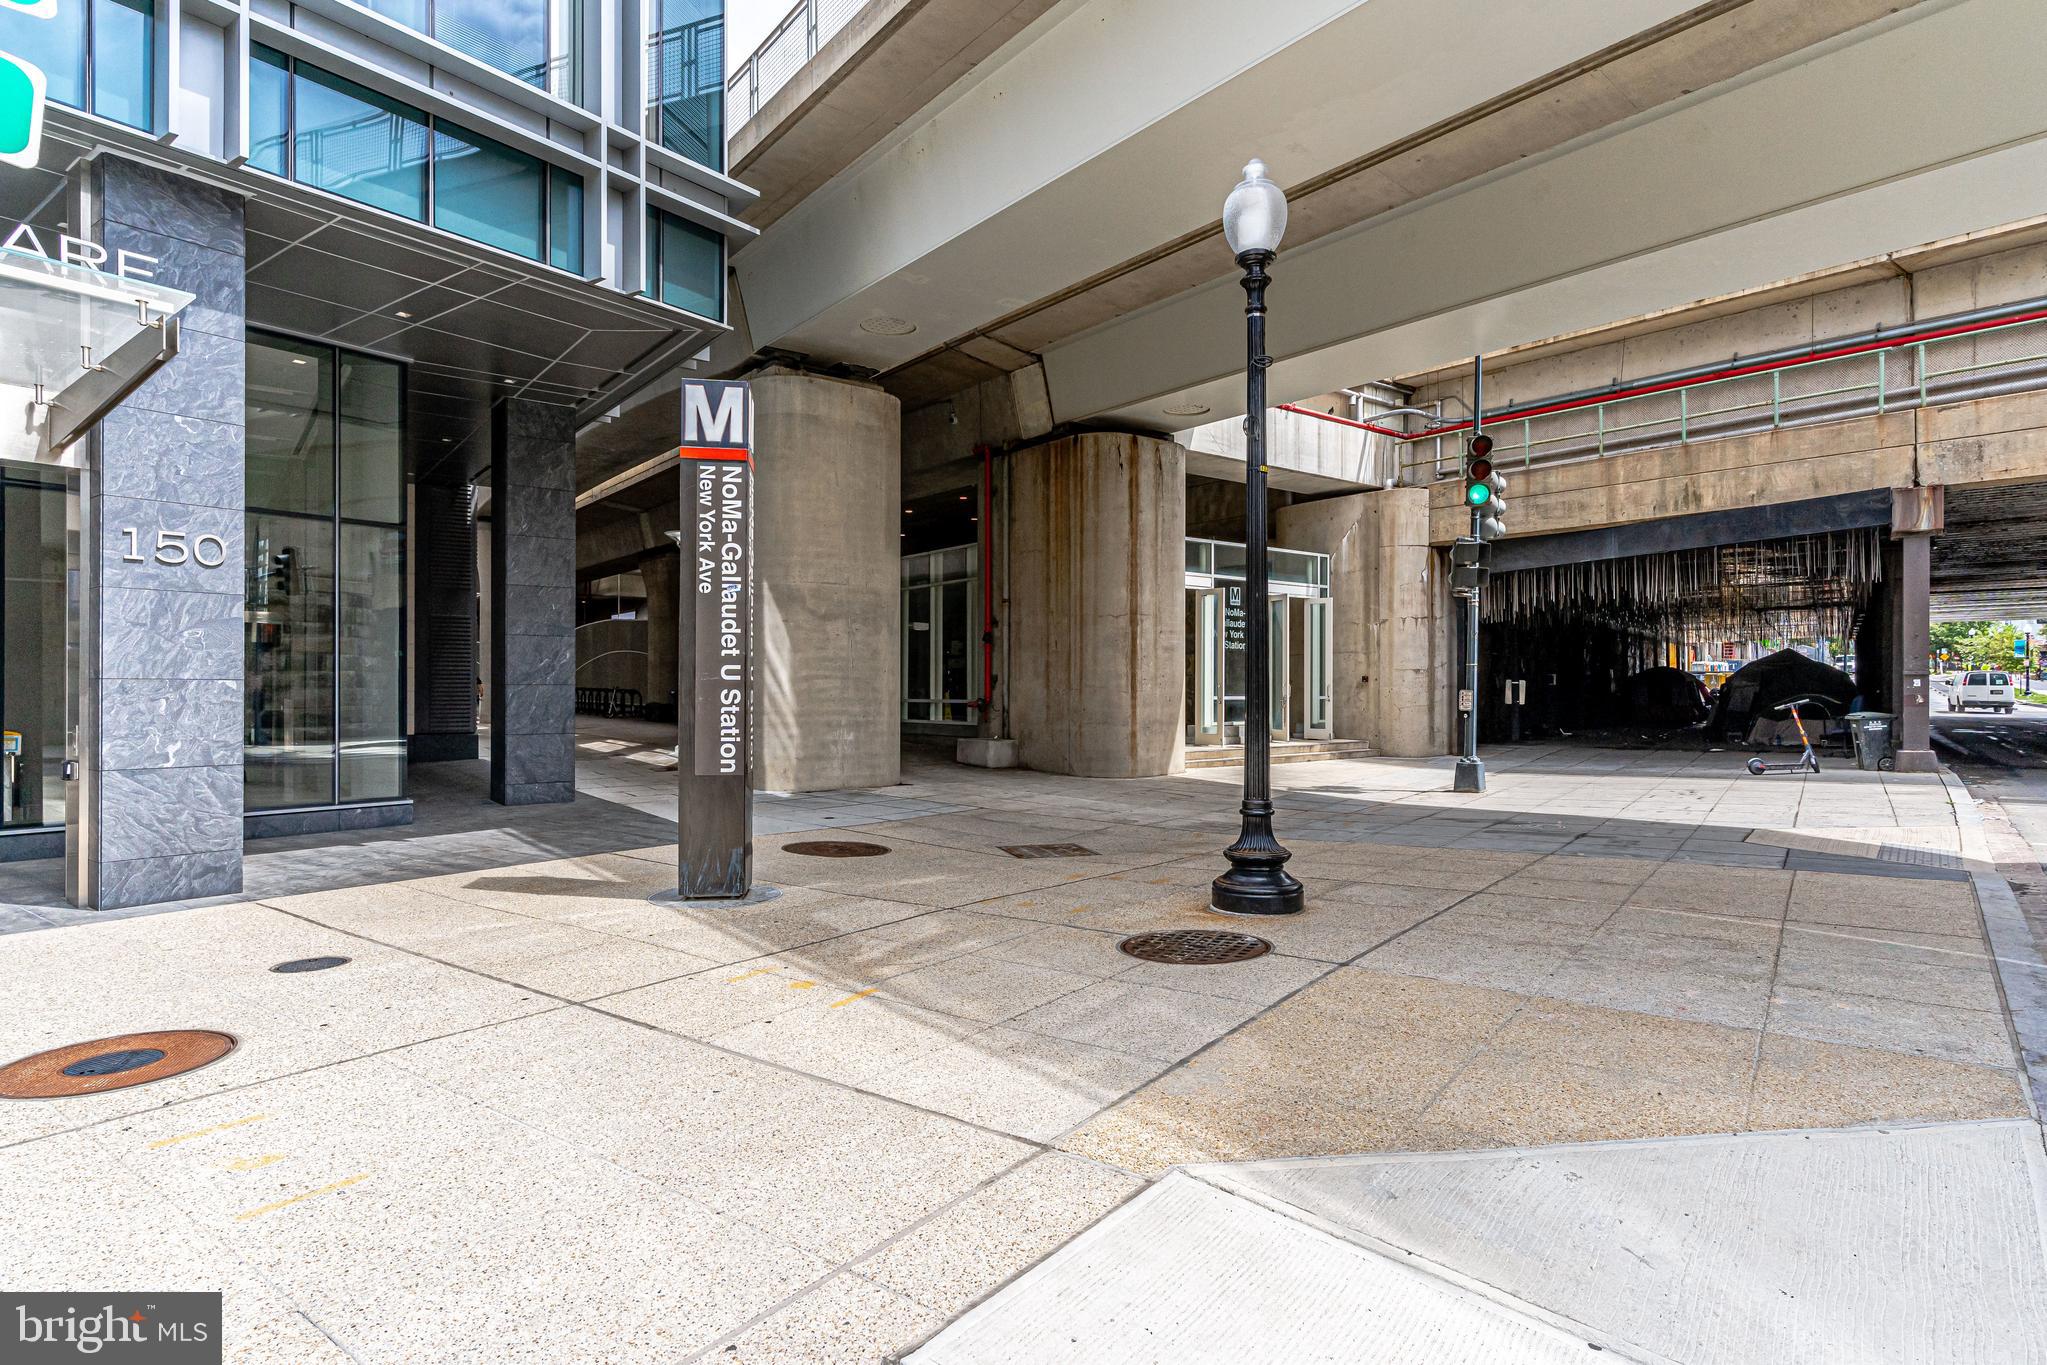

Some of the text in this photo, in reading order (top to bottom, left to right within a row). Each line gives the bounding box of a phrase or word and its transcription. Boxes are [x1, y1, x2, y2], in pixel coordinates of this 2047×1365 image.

[685, 384, 744, 443] M
[123, 527, 227, 567] 150
[699, 465, 716, 594] New York Ave
[720, 466, 743, 773] NoMa-Gallaudet U Station
[1229, 630, 1244, 639] York
